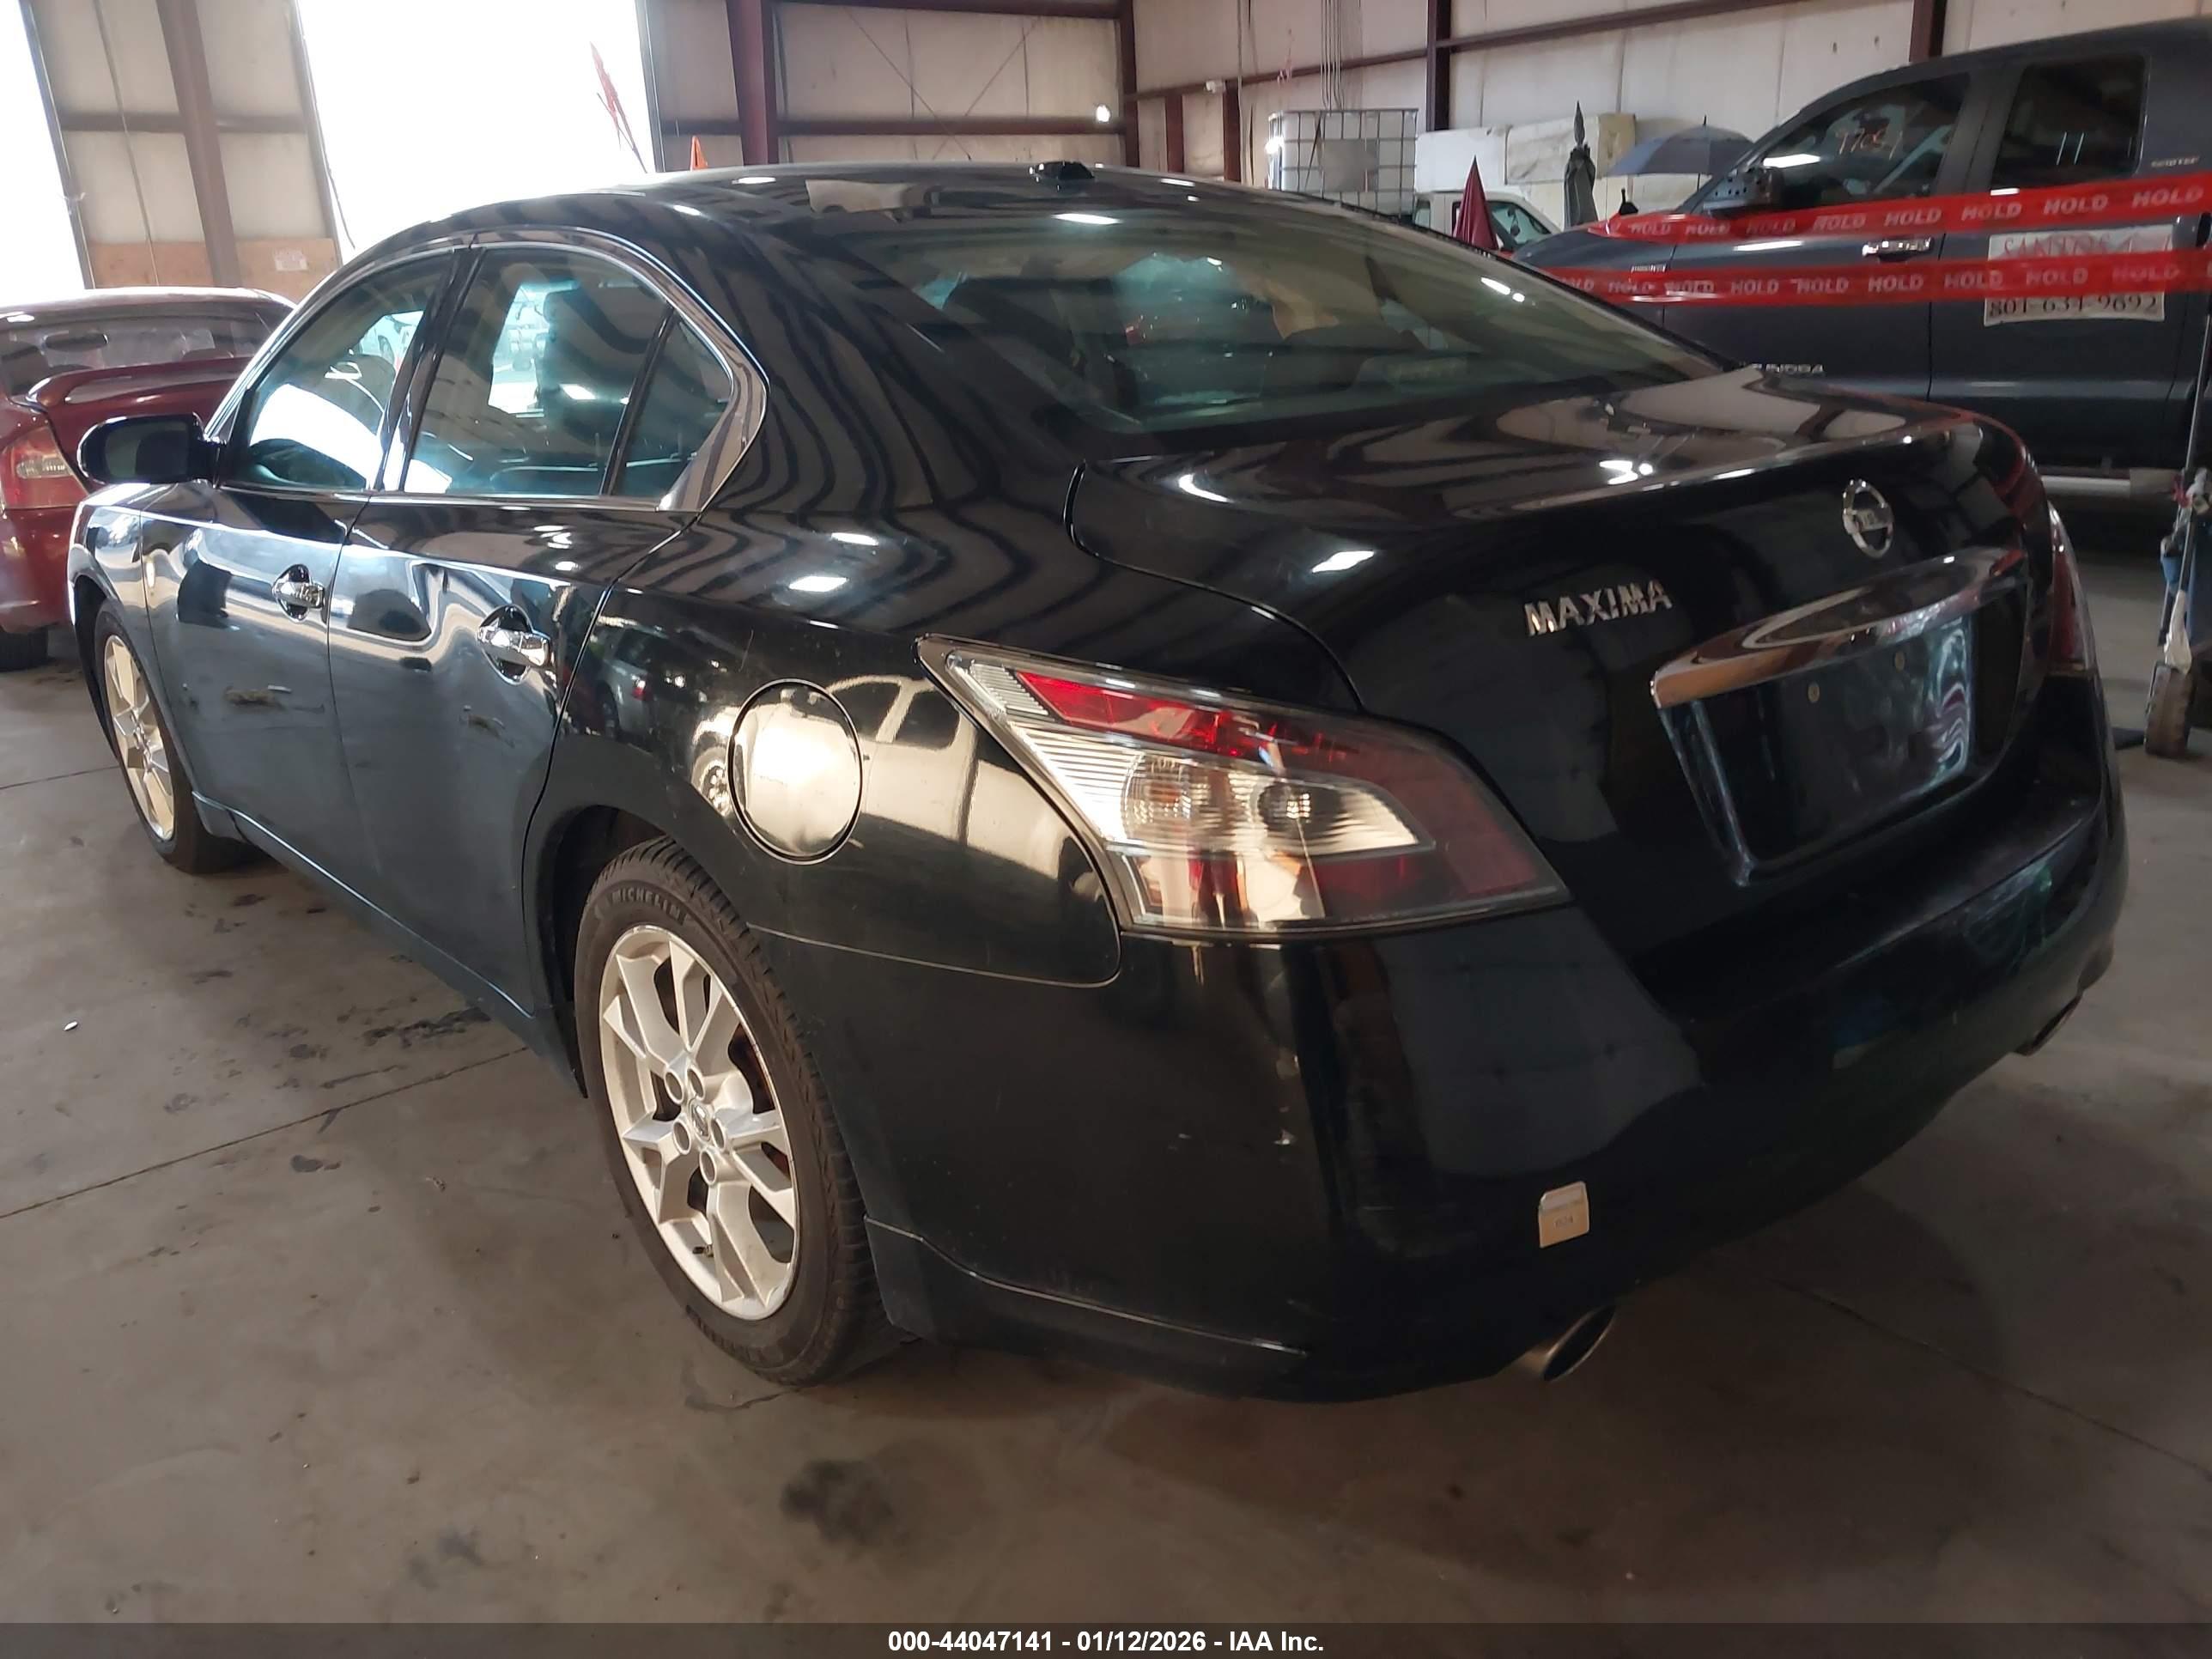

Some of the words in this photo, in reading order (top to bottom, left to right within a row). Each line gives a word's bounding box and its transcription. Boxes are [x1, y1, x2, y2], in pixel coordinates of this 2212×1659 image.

[1883, 207, 1942, 227] HOLD
[1960, 203, 2023, 222] HOLD
[2043, 193, 2110, 216] HOLD
[2131, 184, 2205, 210] HOLD
[1730, 278, 1780, 295] HOLD
[1791, 276, 1850, 295] HOLD
[1868, 272, 1924, 293] HOLD
[1943, 269, 2003, 290] HOLD
[2025, 266, 2089, 287] HOLD
[2112, 263, 2180, 283] HOLD
[1524, 580, 1673, 636] MAXIMA
[611, 887, 681, 921] MICHELIN
